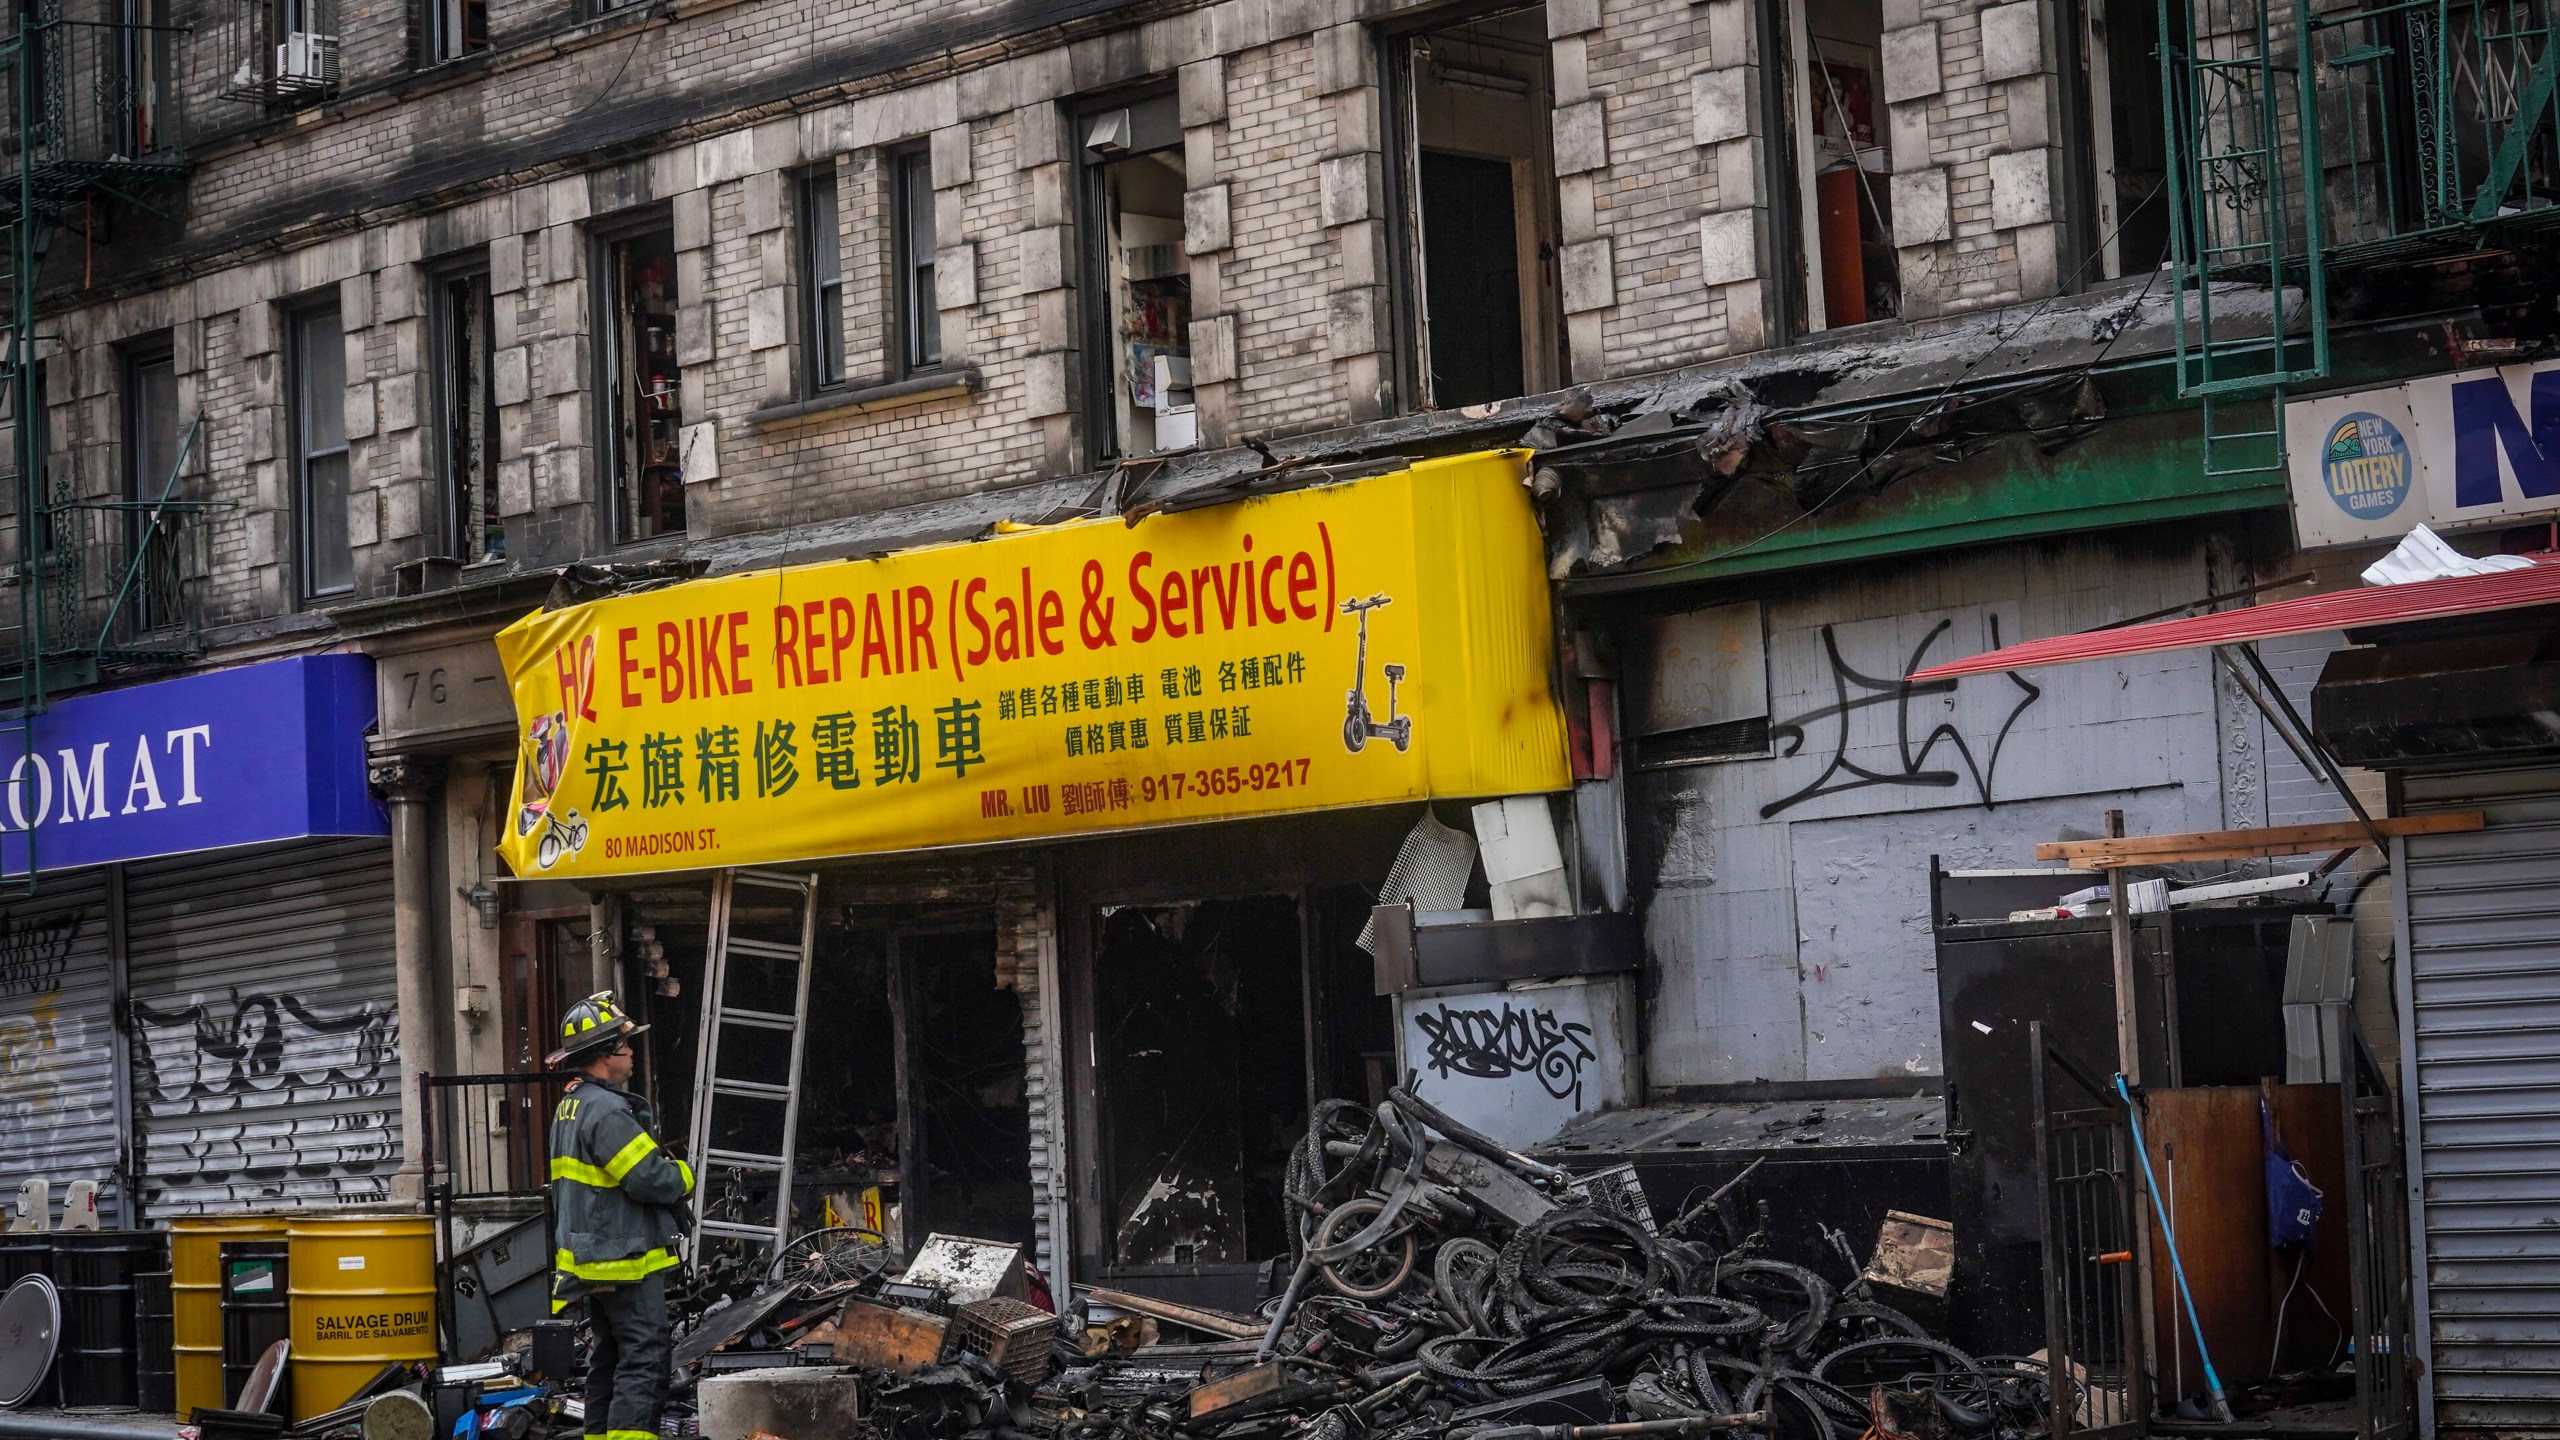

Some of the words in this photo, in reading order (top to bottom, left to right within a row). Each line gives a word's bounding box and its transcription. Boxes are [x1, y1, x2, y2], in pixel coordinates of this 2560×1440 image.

[2358, 417, 2383, 438] NEW
[2362, 435, 2394, 455] YORK
[2329, 453, 2404, 496] LOTTERY
[2349, 490, 2394, 510] GAMES
[555, 634, 598, 725] HQ
[617, 610, 754, 710] E-BIKE
[776, 585, 939, 690] REPAIR
[947, 564, 1066, 683] (Sale
[1079, 558, 1118, 652] &
[1127, 520, 1337, 645] Service)
[403, 667, 448, 710] 76
[998, 672, 1146, 721] 銷售各種電動車
[1160, 664, 1203, 700] 電池
[1218, 650, 1307, 693] 各種配件
[584, 697, 986, 814] 宏旗精修電動車
[1064, 717, 1149, 758] 價格實惠
[0, 723, 211, 832] OMAT
[981, 789, 1015, 819] MR.
[1023, 784, 1051, 814] LIU
[1140, 758, 1313, 803] 917-365-9217
[605, 837, 622, 859] 80
[625, 831, 695, 857] MADISON
[698, 828, 720, 851] ST.
[316, 1314, 389, 1330] SALVAGE
[394, 1310, 429, 1326] DRUM
[317, 1331, 353, 1341] BARRIL
[356, 1329, 370, 1339] DE
[373, 1325, 429, 1339] SALVAMENTO
